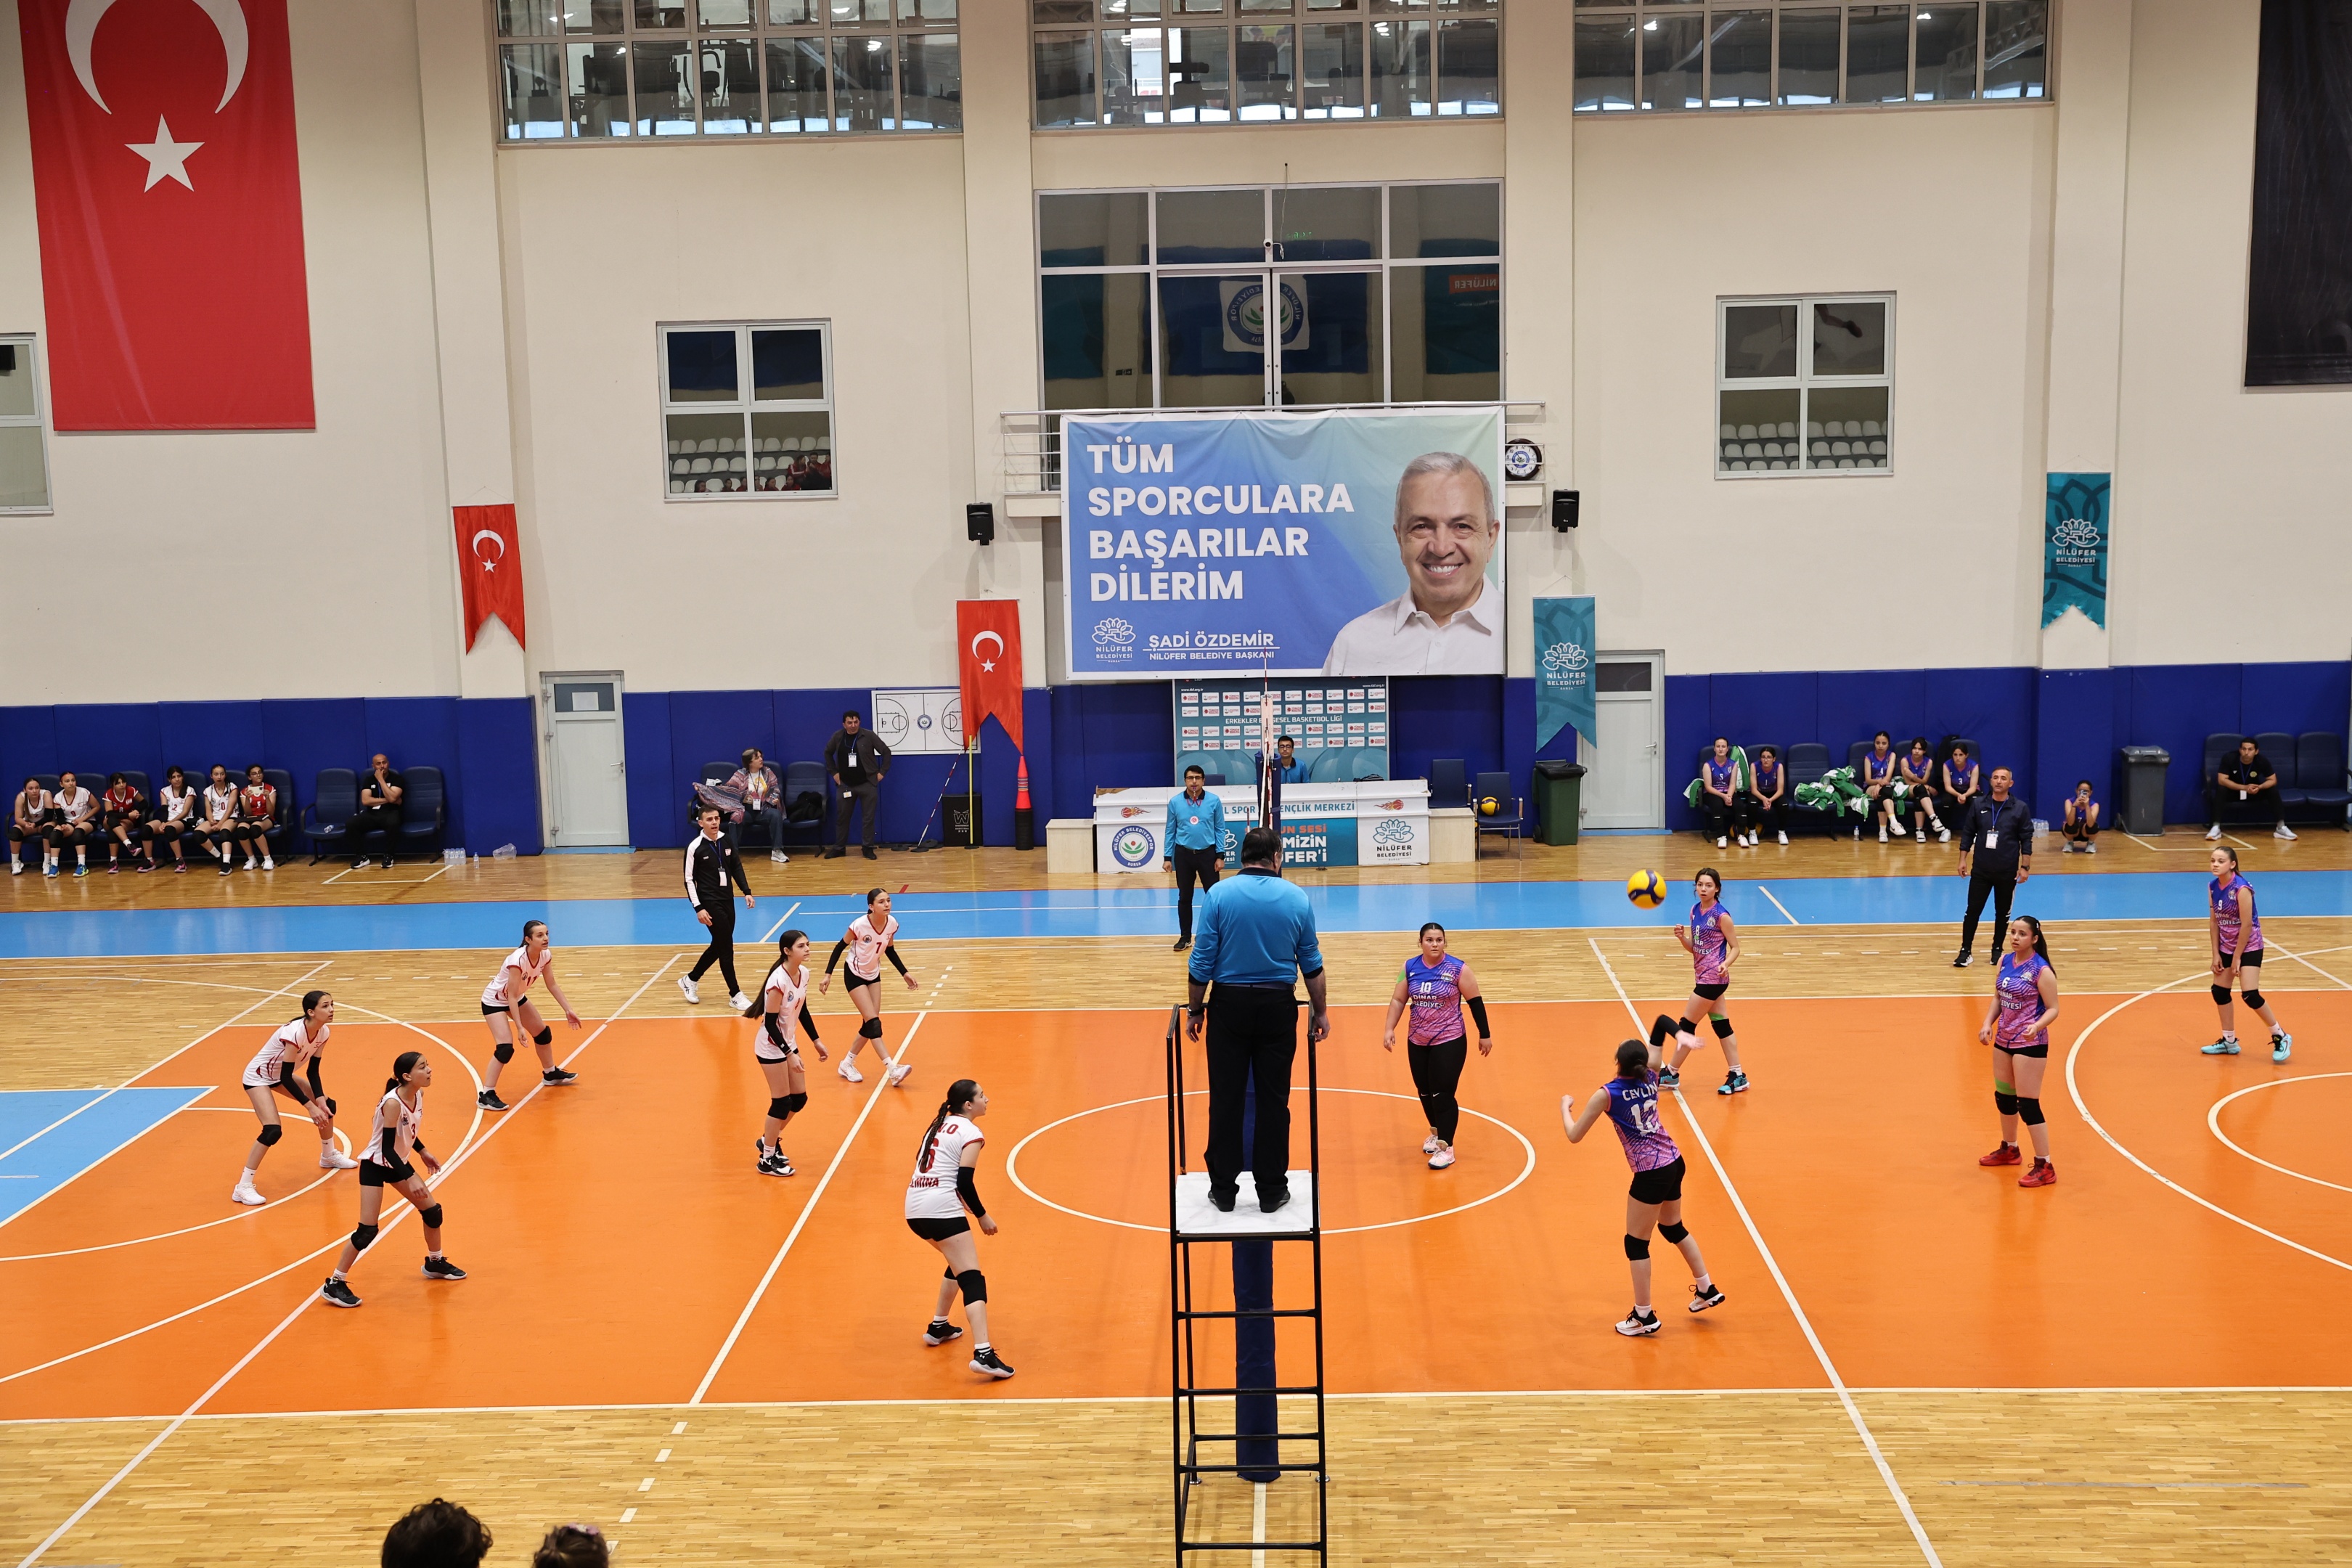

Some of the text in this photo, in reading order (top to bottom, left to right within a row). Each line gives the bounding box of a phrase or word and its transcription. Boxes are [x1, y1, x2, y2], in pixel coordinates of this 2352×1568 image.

[1087, 436, 1174, 474] TÜM
[1088, 483, 1355, 517] SPORCULARA
[1090, 527, 1309, 569] BAŞARILAR
[2056, 547, 2096, 556] NİLÜFER
[1090, 562, 1244, 602] DİLERİM
[1149, 629, 1274, 651] ŞADİ ÖZDEMİR
[1149, 650, 1274, 660] NİLÜFER BELEDİYE BAŞKANI
[1280, 801, 1312, 814] ENÇLİK
[1314, 801, 1355, 812] MERKEZİ
[1299, 823, 1326, 833] SESİ
[1113, 827, 1153, 851] NİLÜFER BELEDİYESPOR
[1282, 834, 1327, 849] MİZİN
[1282, 848, 1327, 863] FER'İ
[2218, 899, 2223, 911] 9
[1695, 925, 1700, 936] 8
[875, 942, 883, 954] 7
[526, 975, 538, 987] 11
[1420, 981, 1432, 993] 10
[2001, 976, 2011, 988] 6
[1630, 1098, 1660, 1137] 12
[411, 1123, 416, 1140] 3
[919, 1138, 939, 1174] 6
